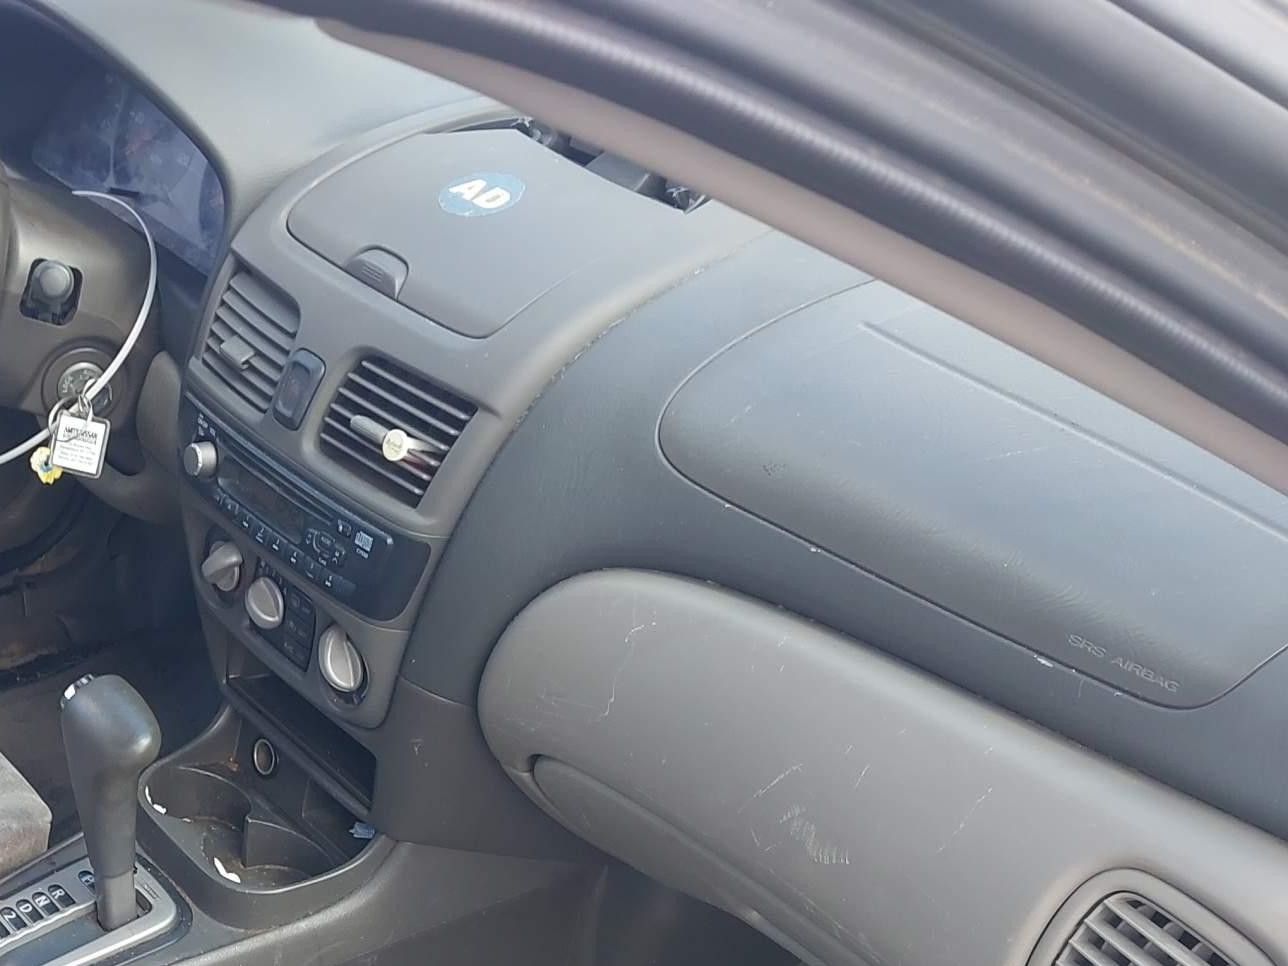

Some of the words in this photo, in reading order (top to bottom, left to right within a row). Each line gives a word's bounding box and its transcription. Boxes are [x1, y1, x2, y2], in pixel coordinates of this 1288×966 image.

[448, 179, 510, 208] AD
[1068, 634, 1106, 658] SRS
[1112, 657, 1180, 692] AIRBAG
[51, 888, 65, 899] R
[19, 902, 32, 912] D
[34, 896, 50, 907] N
[4, 911, 16, 920] 2
